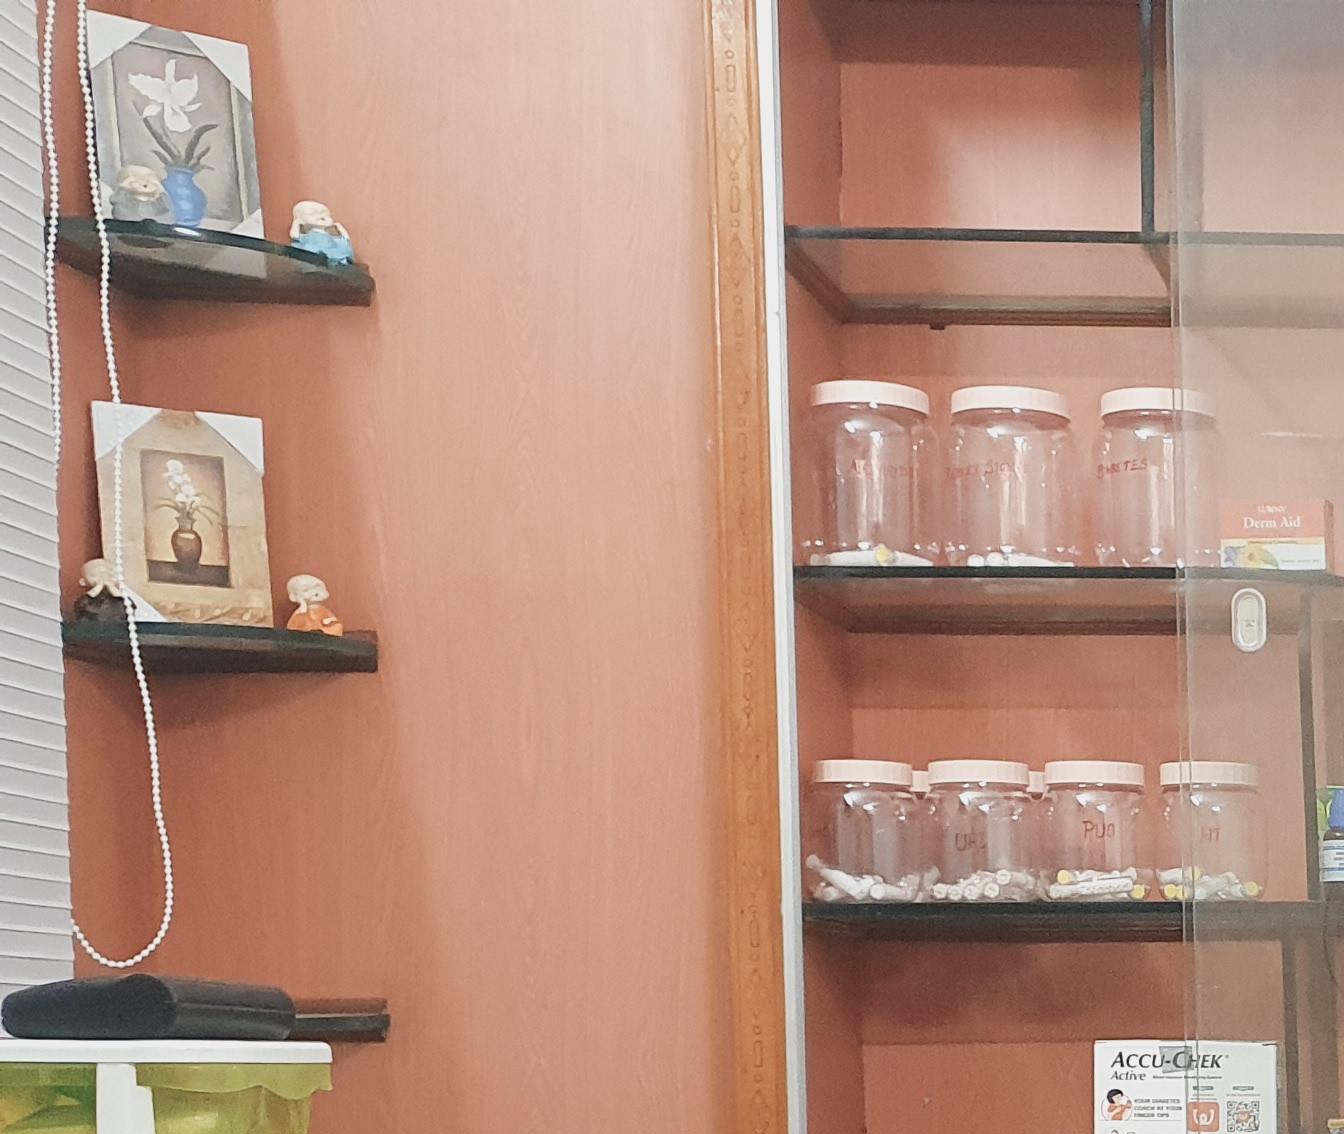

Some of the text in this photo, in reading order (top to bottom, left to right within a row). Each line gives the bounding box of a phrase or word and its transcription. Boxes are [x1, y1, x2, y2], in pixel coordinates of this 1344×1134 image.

[1243, 516, 1301, 529] Derm Aid
[1110, 1051, 1223, 1069] ACCU-CHEK
[1110, 1069, 1147, 1081] Active
